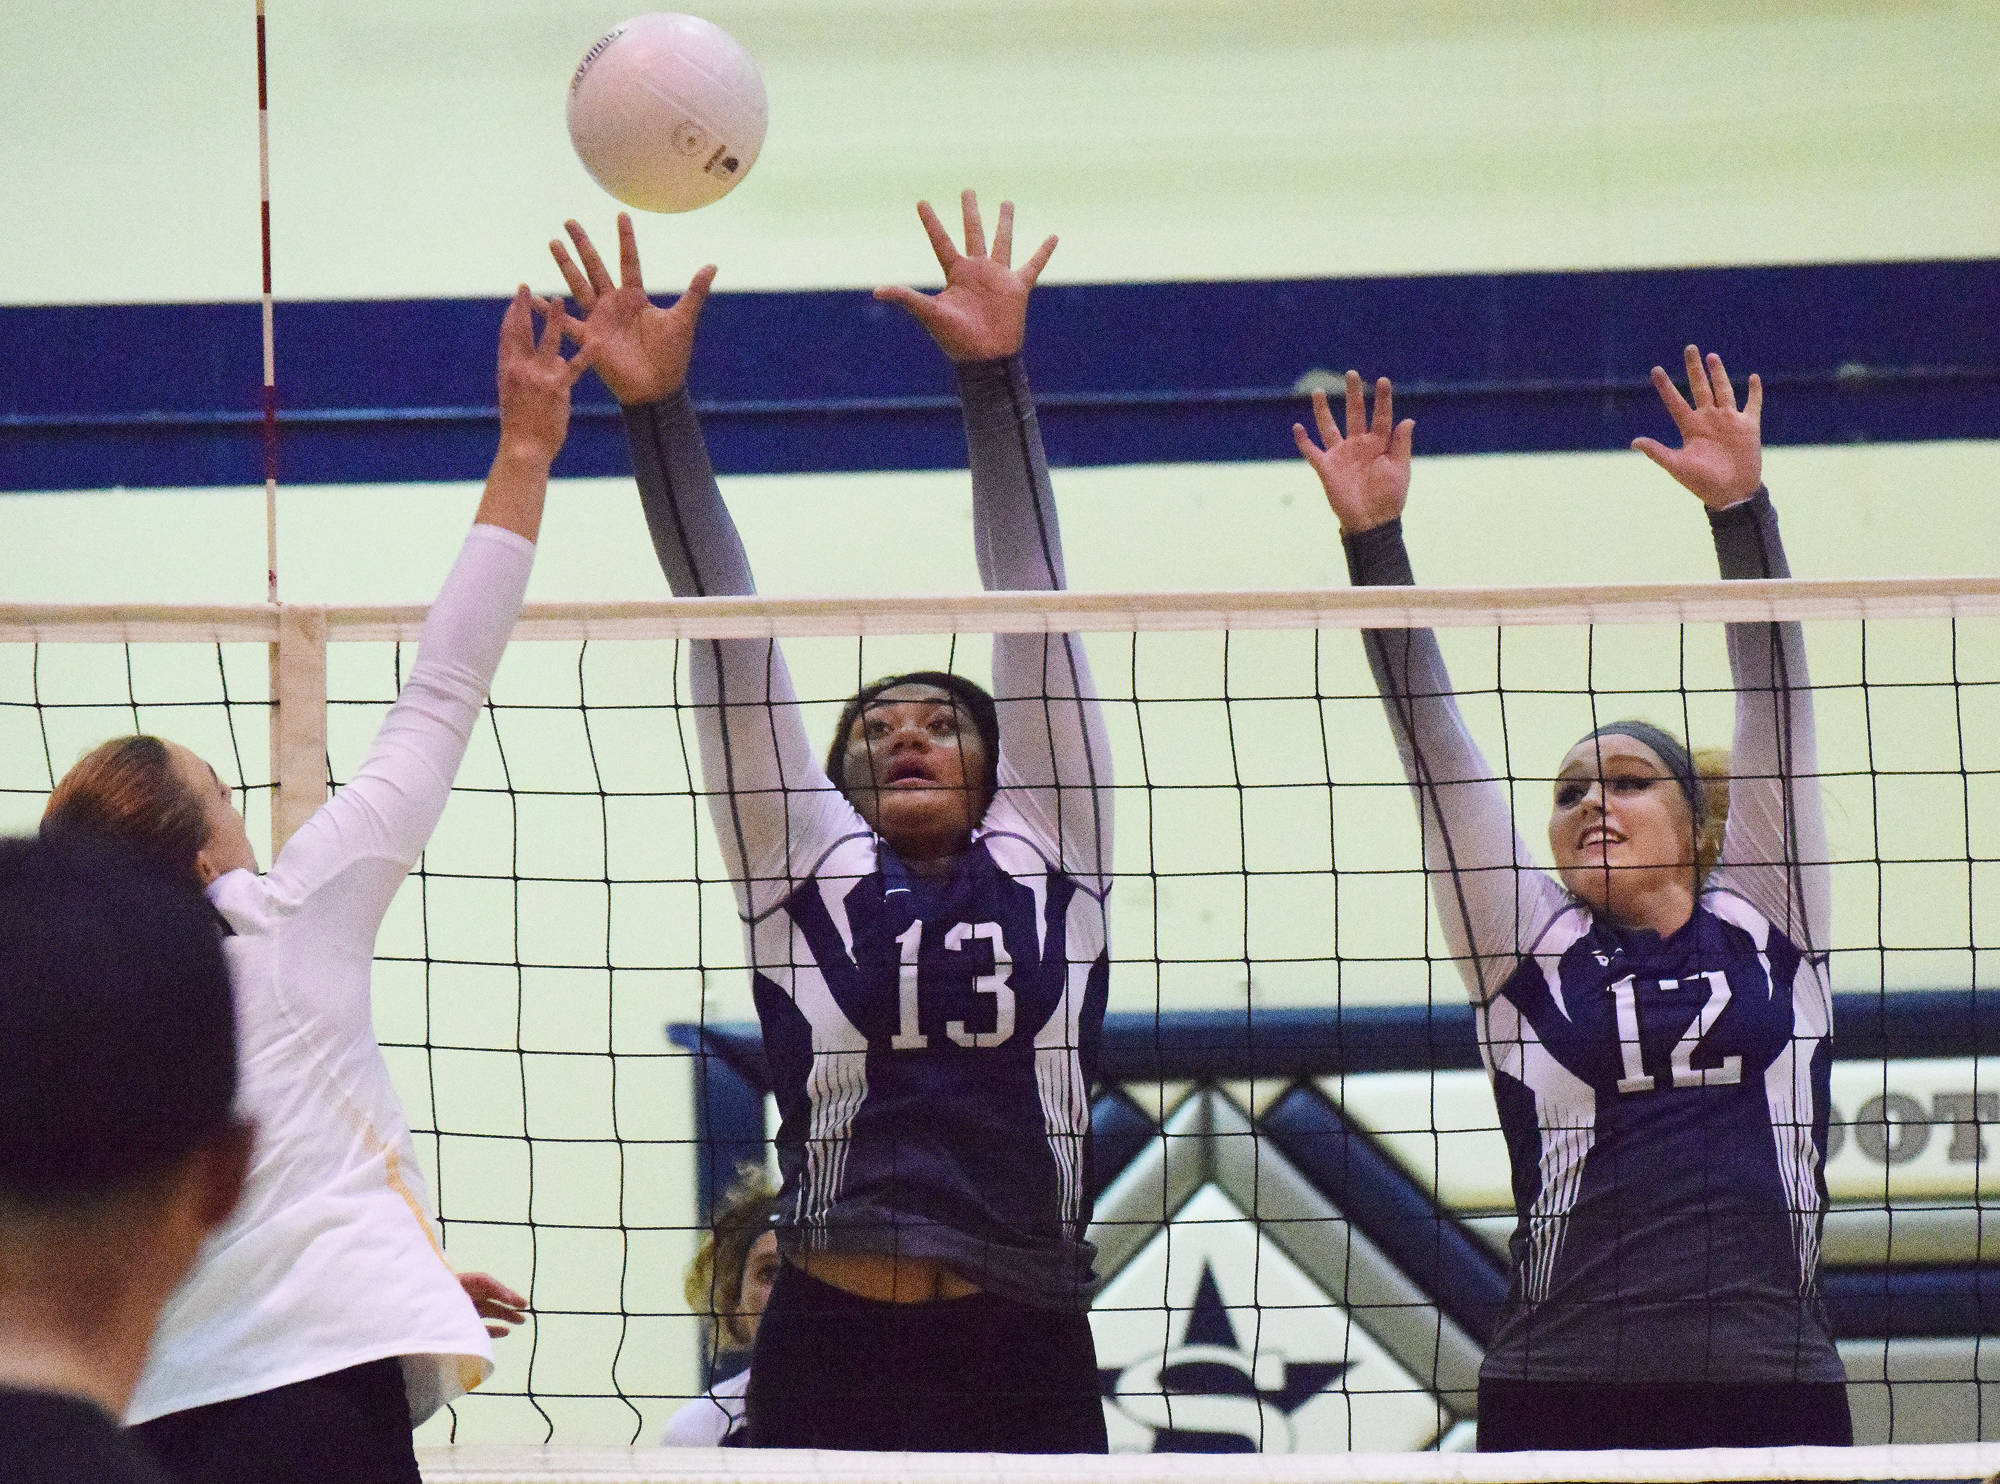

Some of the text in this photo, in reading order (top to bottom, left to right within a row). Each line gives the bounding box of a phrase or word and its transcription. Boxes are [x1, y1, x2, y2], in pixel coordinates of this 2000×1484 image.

[891, 918, 1016, 1050] 13
[1606, 970, 1743, 1094] 12
[1827, 1089, 2000, 1166] OT
